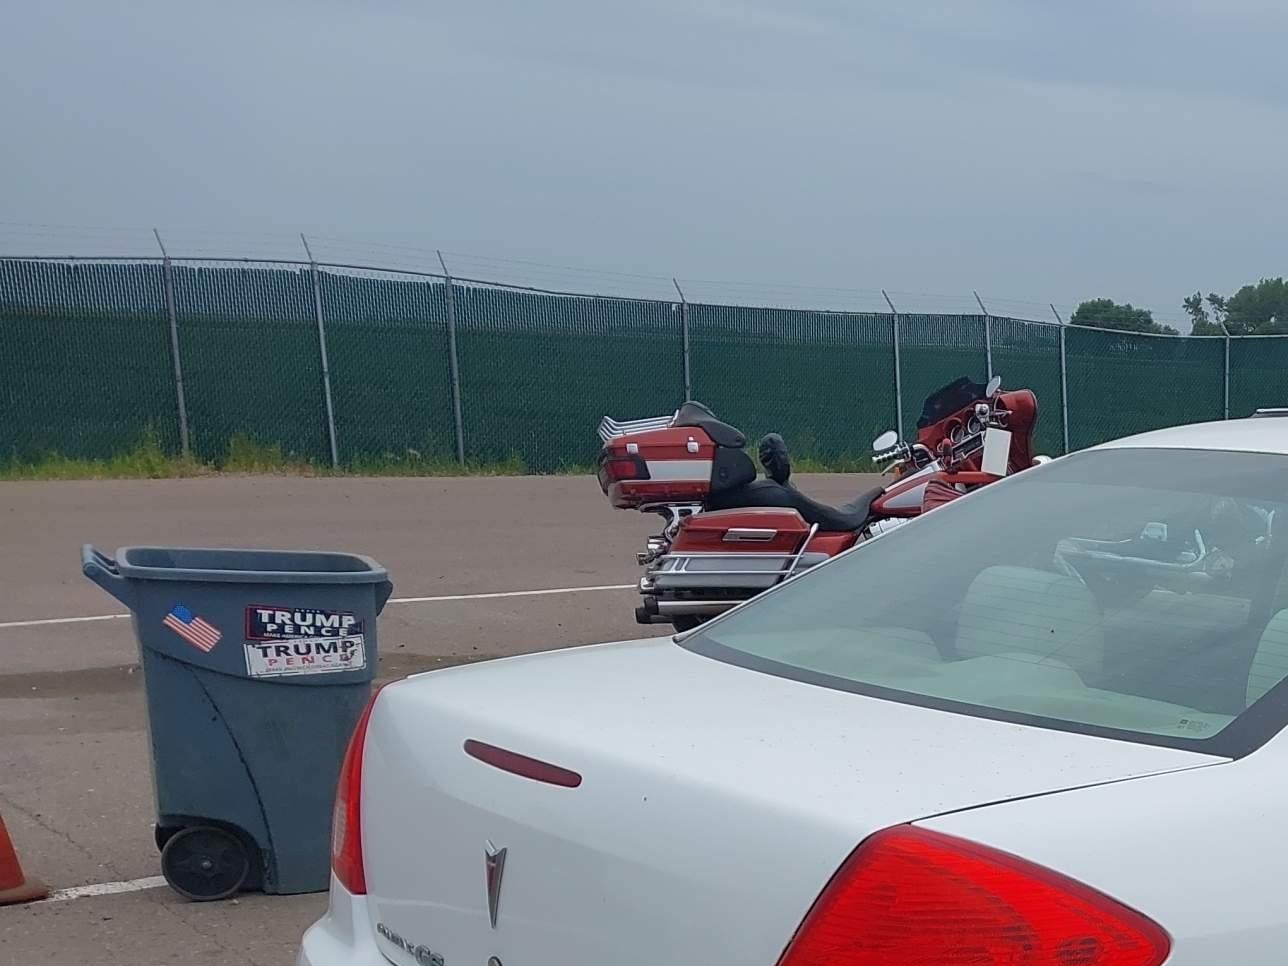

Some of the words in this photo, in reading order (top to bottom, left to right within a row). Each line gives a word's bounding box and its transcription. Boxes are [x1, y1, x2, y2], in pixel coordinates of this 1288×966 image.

[256, 609, 356, 628] TRUMP
[266, 623, 349, 637] PENCE
[256, 640, 355, 658] TRUMP
